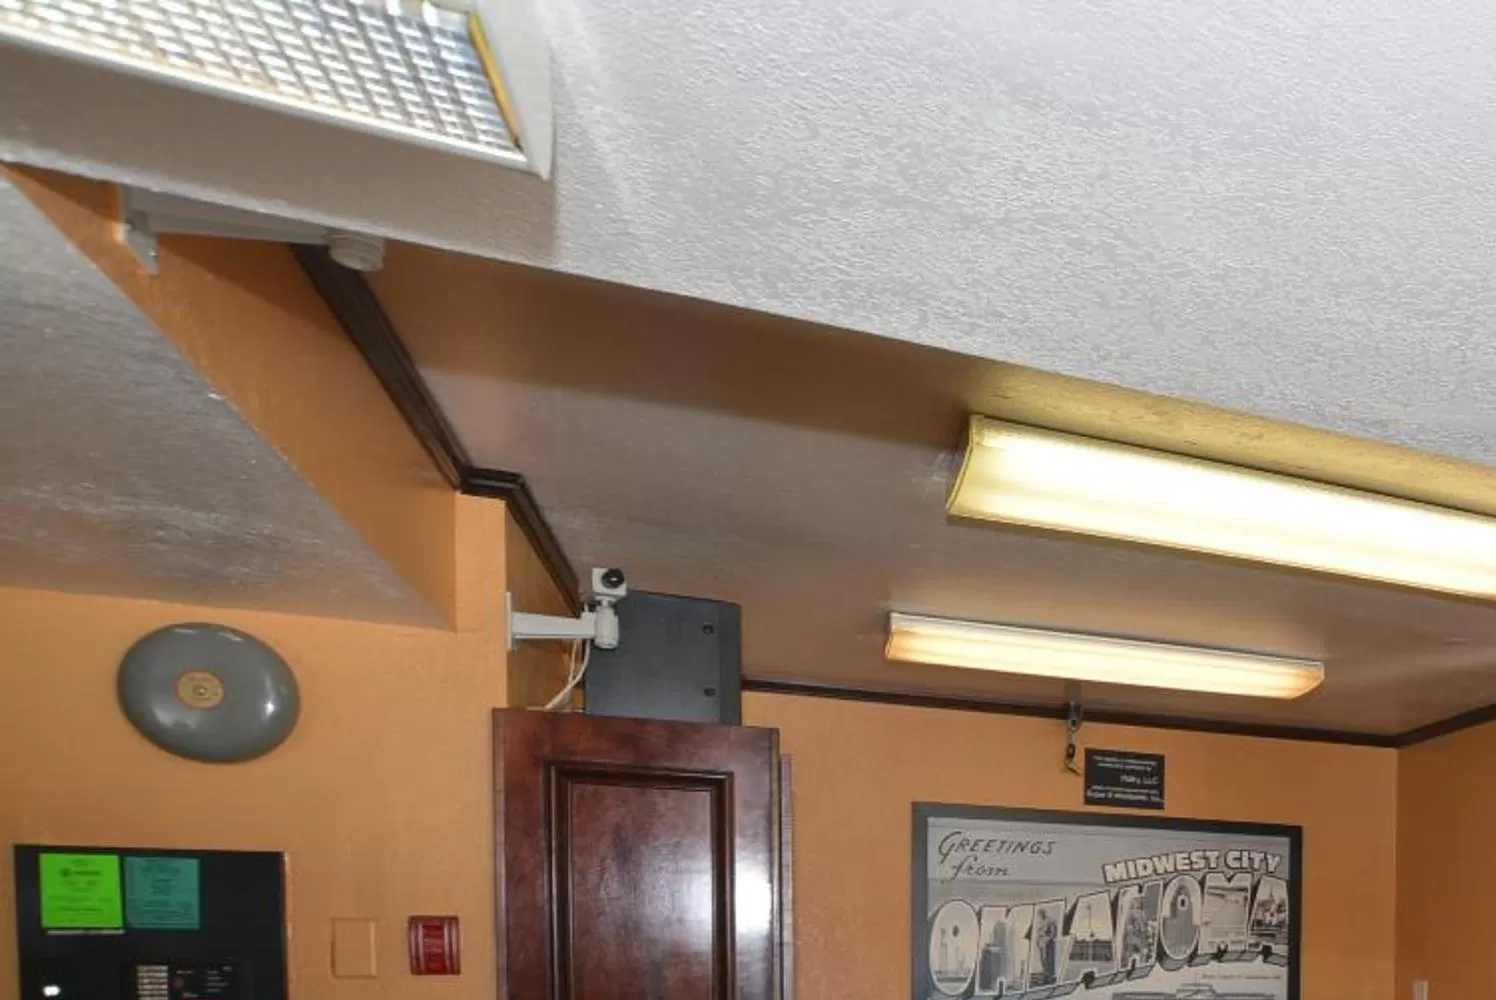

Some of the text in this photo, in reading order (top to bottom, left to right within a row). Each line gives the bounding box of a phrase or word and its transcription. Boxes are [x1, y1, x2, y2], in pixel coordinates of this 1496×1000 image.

[938, 830, 1057, 864] GREETINGS
[950, 853, 1010, 881] from
[1104, 849, 1283, 884] MIDWEST CITY
